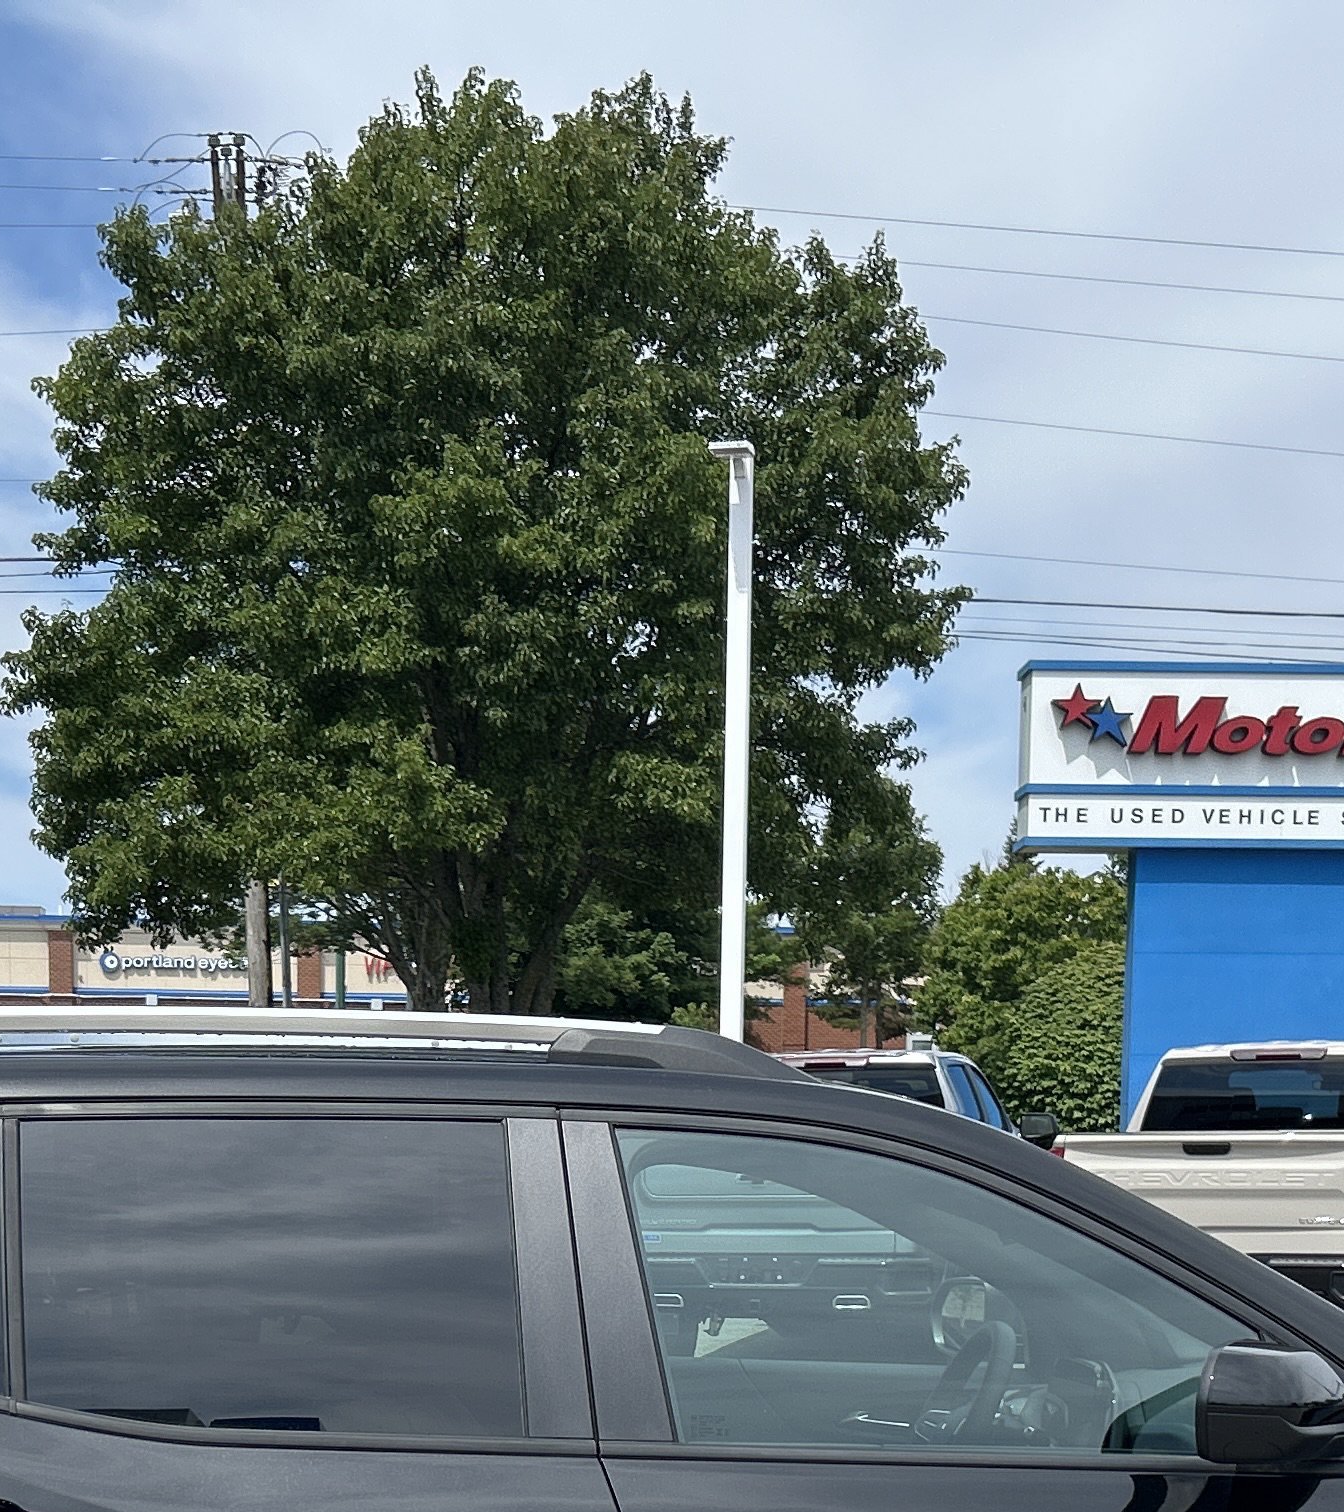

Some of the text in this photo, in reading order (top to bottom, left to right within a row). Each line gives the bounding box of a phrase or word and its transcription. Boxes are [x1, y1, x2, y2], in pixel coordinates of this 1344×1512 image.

[1039, 807, 1089, 823] THE
[1110, 808, 1185, 824] USED
[1202, 808, 1320, 826] VEHICLE
[121, 954, 196, 971] portland
